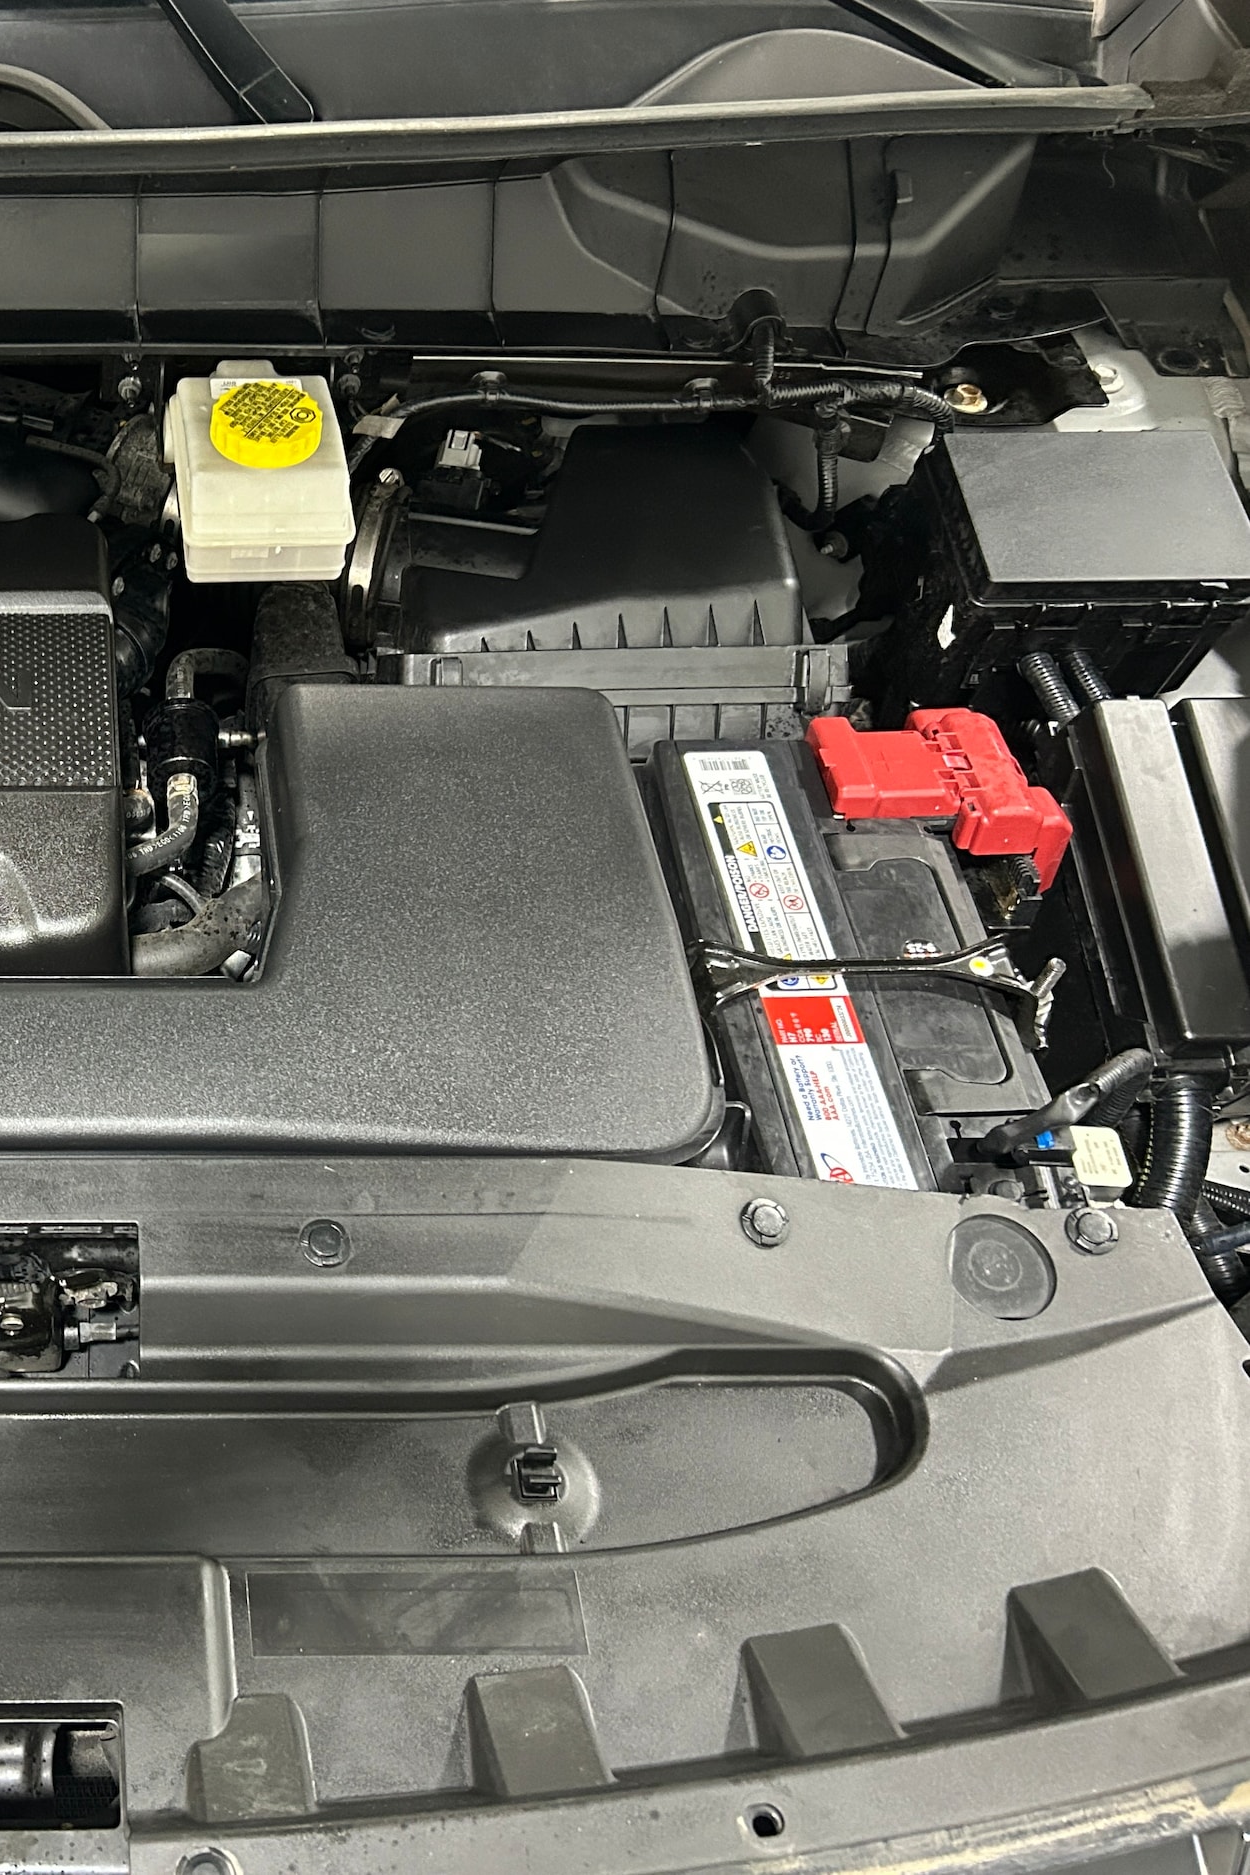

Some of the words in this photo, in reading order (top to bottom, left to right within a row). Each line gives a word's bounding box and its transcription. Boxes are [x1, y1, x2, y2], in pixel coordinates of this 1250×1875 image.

[724, 855, 760, 932] DANGER/POISON
[786, 1032, 798, 1042] H7
[791, 1067, 805, 1091] Battery
[795, 1055, 812, 1085] Support?
[809, 1070, 827, 1104] AAA-HELP
[801, 1101, 815, 1120] Need
[806, 1088, 823, 1120] Warranty
[821, 1107, 832, 1120] 800
[822, 1085, 840, 1120] AAA.com
